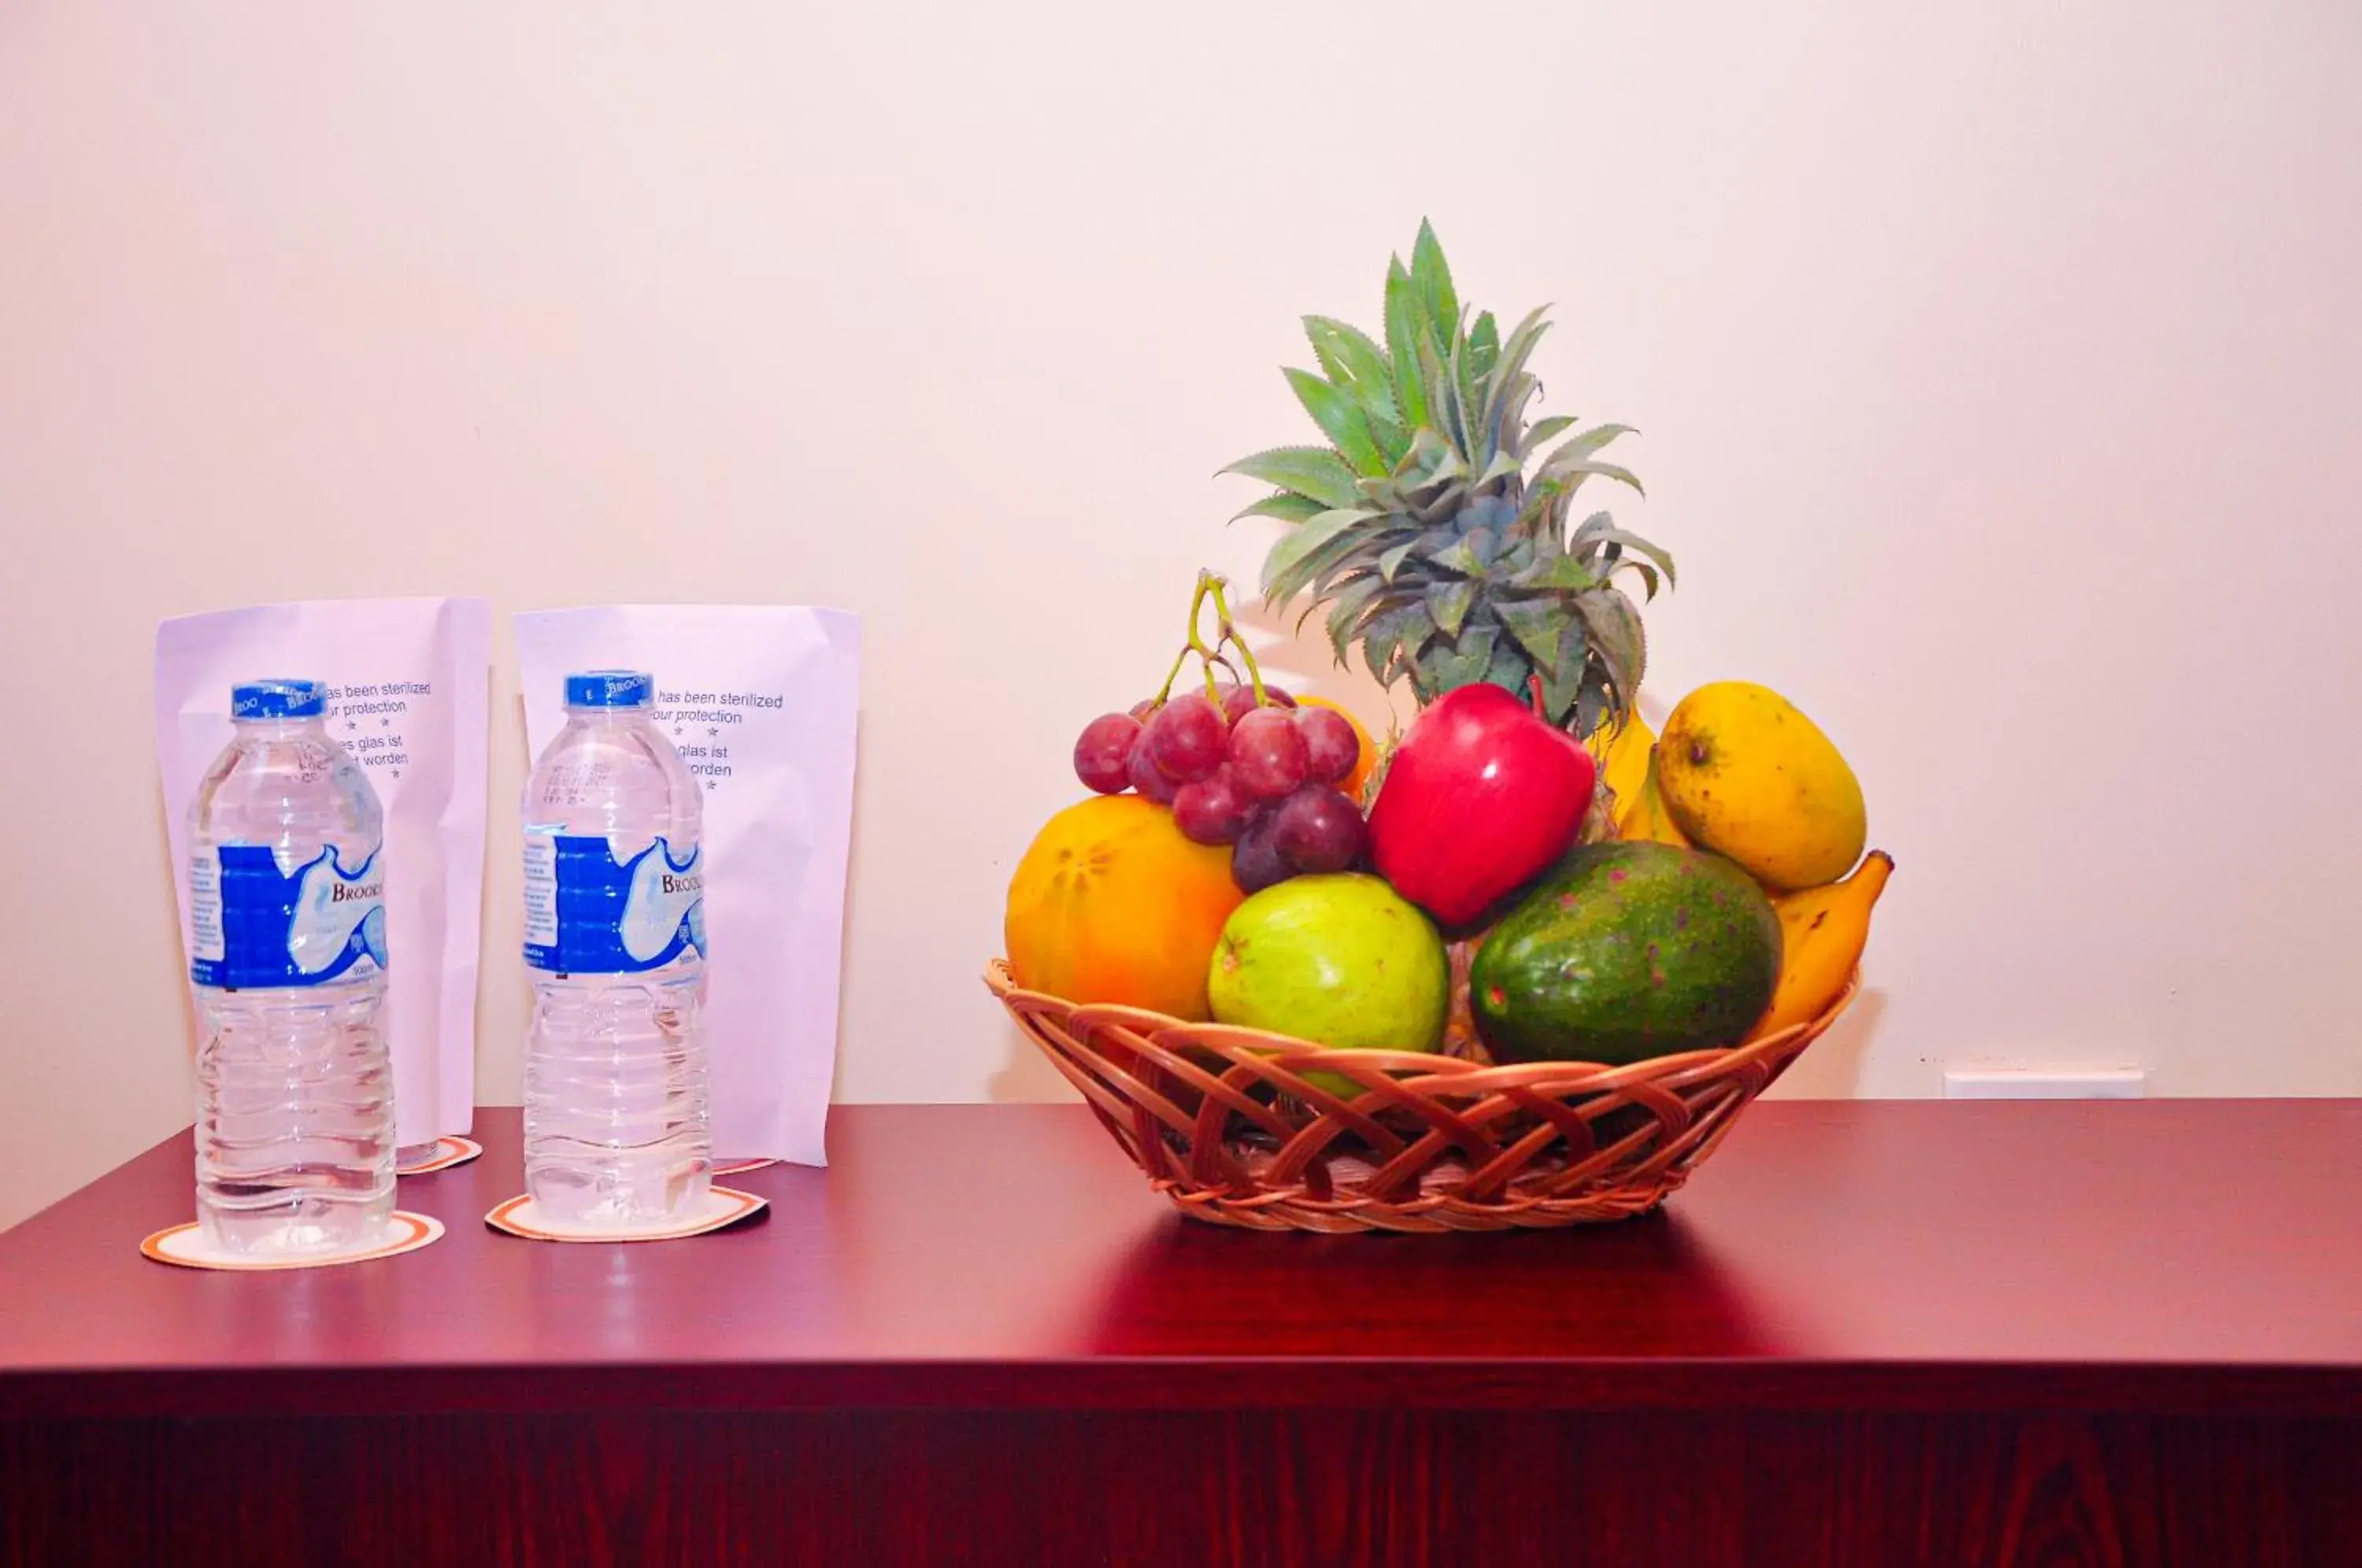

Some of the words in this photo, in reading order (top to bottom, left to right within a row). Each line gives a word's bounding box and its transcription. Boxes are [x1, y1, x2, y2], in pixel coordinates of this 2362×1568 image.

[327, 688, 342, 700] as
[345, 685, 379, 698] been
[381, 682, 431, 695] sterilized
[657, 690, 681, 703] has
[684, 689, 716, 704] been
[720, 693, 783, 708] sterilized
[343, 701, 406, 717] protection
[651, 710, 673, 720] our
[674, 709, 742, 723] protection
[358, 737, 384, 752] glas
[388, 735, 402, 747] ist
[711, 745, 727, 758] ist
[364, 753, 408, 766] worden
[690, 764, 731, 777] orden
